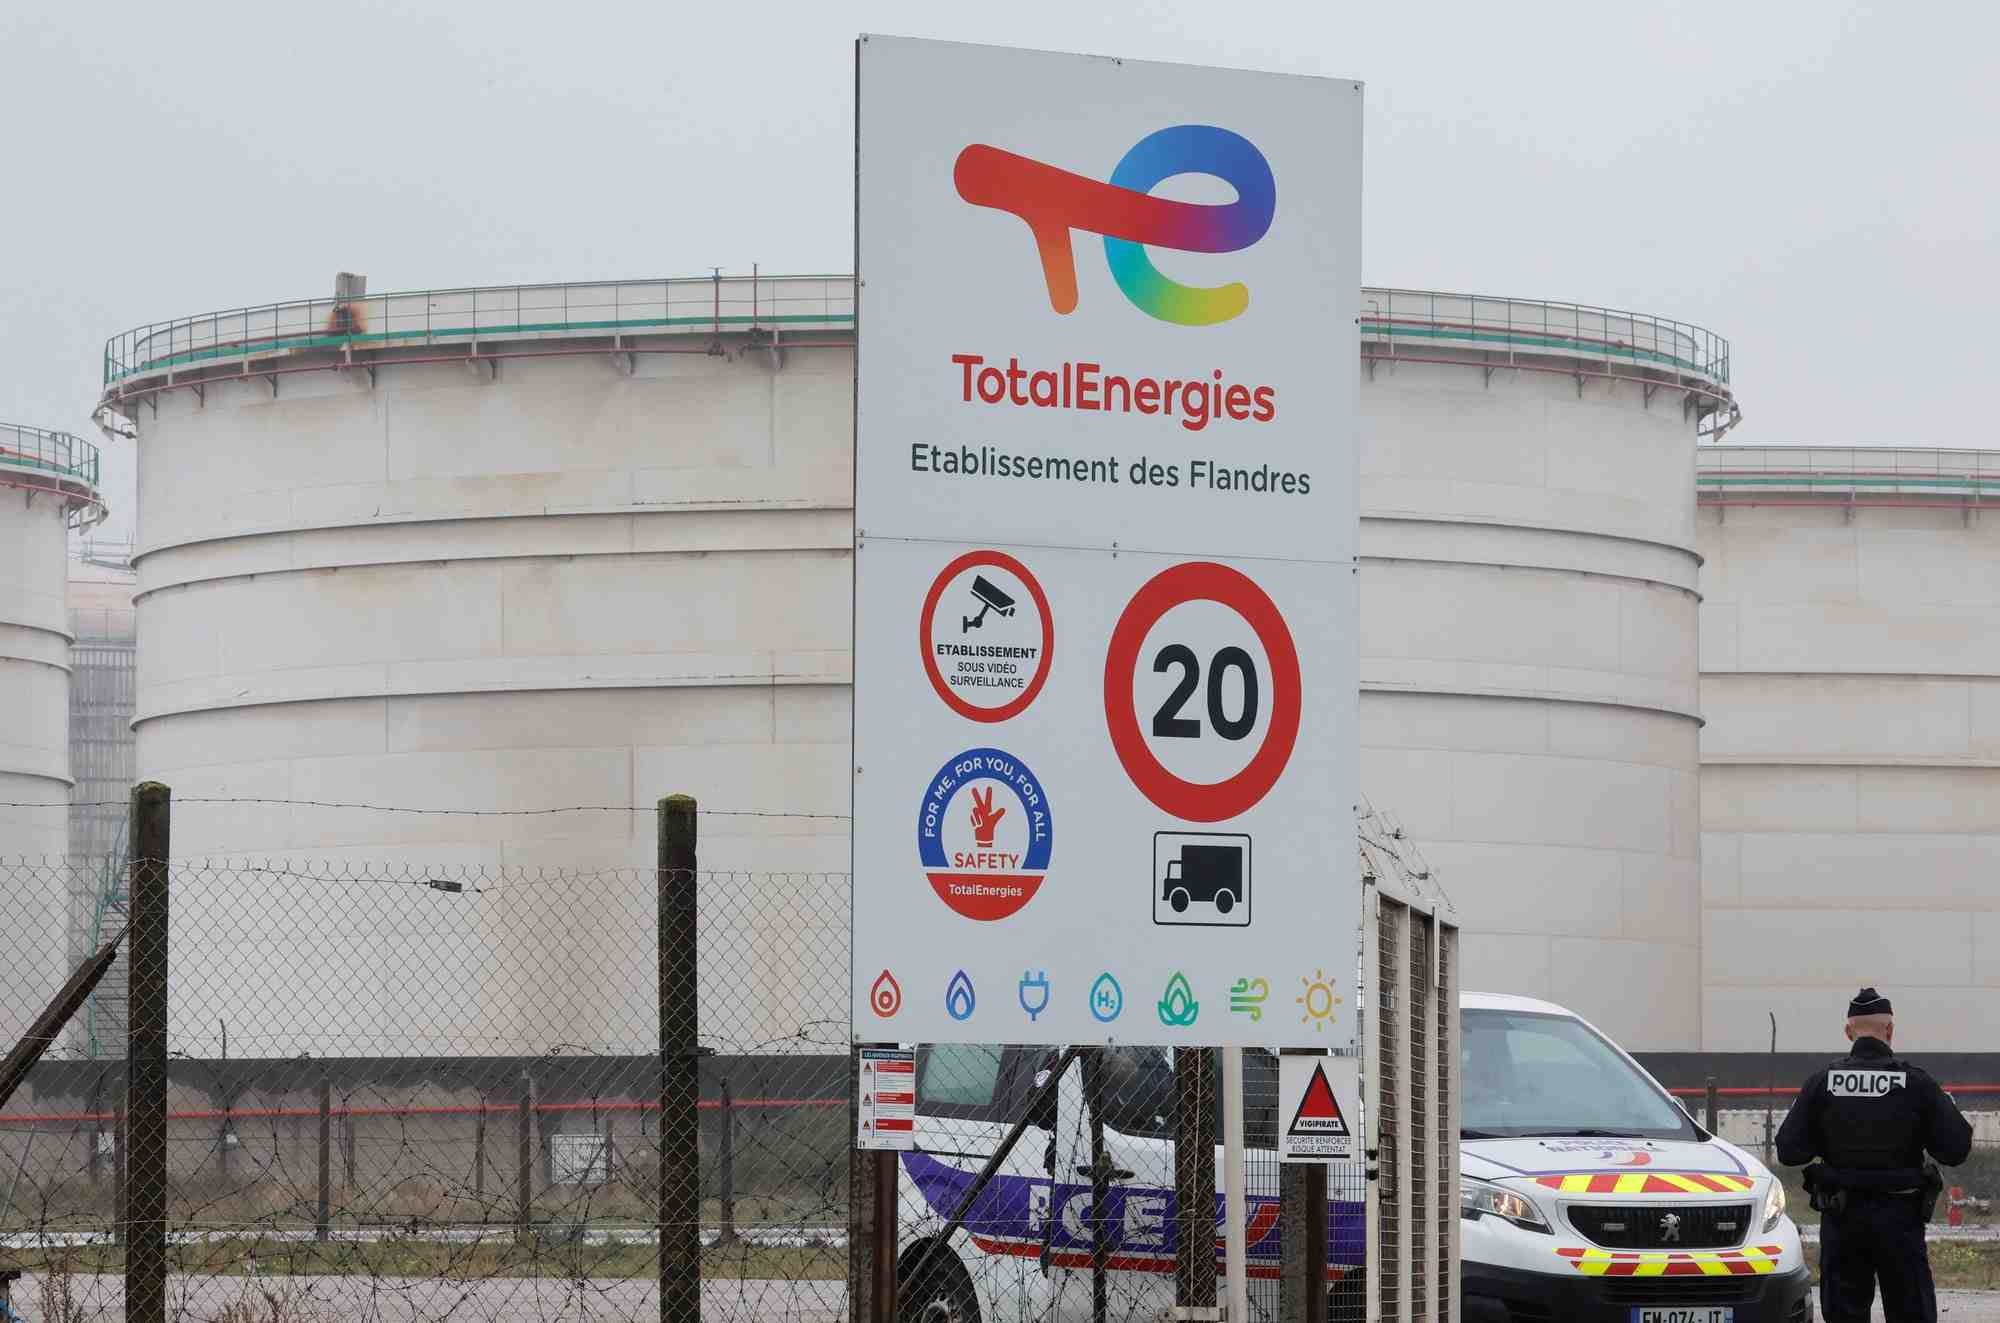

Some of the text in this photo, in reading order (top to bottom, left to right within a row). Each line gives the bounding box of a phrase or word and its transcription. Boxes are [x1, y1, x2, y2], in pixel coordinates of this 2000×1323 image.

[951, 354, 1275, 431] TotalEnergies
[911, 442, 1311, 495] Etablissement des Flandres
[936, 644, 1037, 659] ETABLISSEMENT
[957, 662, 985, 673] SOUS
[950, 675, 1024, 689] SURVEILLANCE
[1152, 643, 1259, 741] 20
[925, 802, 940, 837] FOR
[955, 757, 983, 778] FOR
[1016, 774, 1039, 807] FOR
[1033, 810, 1046, 842] ALL
[954, 852, 1019, 869] SAFETY
[949, 884, 1023, 898] TotalEnergies
[1299, 1120, 1339, 1128] VIGIPIRATE
